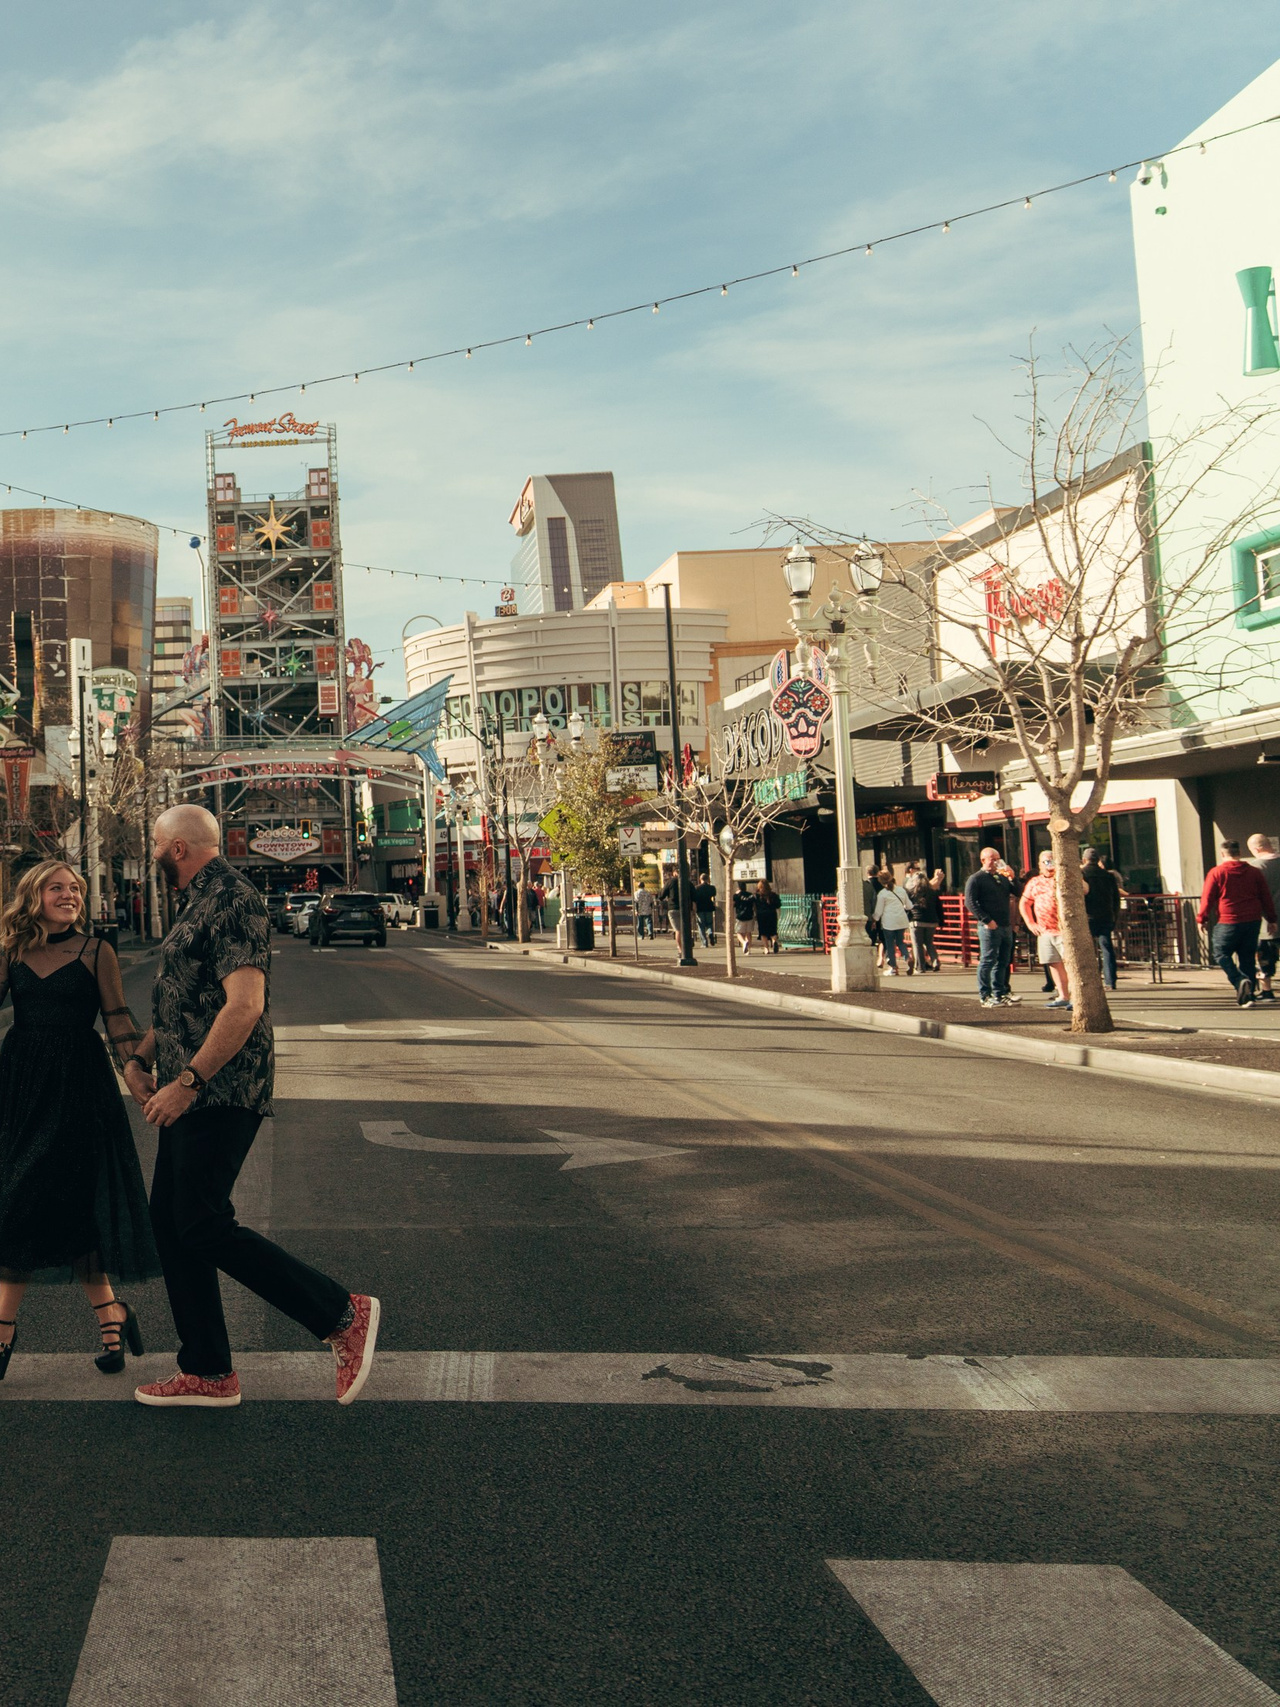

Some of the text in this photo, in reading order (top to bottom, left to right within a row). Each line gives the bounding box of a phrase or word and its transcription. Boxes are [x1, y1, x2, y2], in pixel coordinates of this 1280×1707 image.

[223, 412, 319, 446] Fremont Street
[241, 438, 299, 448] EXPERIENCE
[624, 712, 661, 727] ST
[941, 773, 994, 794] Therapy
[391, 838, 409, 846] Vegas
